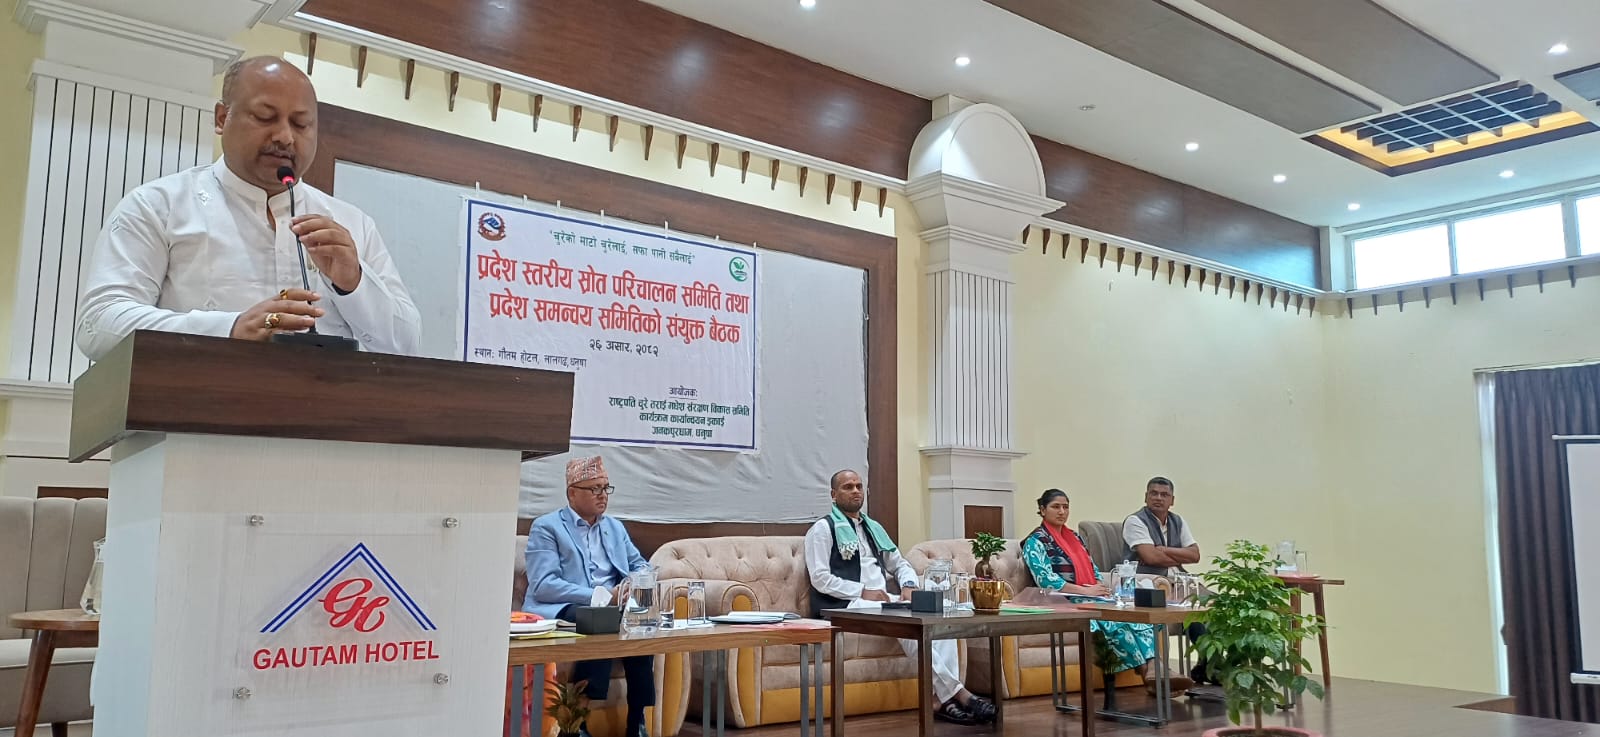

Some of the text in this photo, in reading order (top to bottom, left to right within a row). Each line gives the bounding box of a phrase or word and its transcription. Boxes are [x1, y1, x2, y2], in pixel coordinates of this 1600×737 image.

[579, 234, 597, 248] माटो
[632, 245, 648, 257] सफा
[651, 247, 666, 260] पानी
[477, 249, 750, 315] प्रदेश स्तरीय स्रोत परिचालन समिति तथा
[489, 287, 741, 345] प्रदेश समन्वय समितिको संयुक्त बैठक
[498, 346, 517, 361] गौतम
[589, 338, 602, 352] २६
[635, 343, 659, 357] २०८२
[608, 396, 636, 408] राष्ट्रपति
[638, 397, 648, 410] चुरे
[650, 398, 666, 411] तराई
[686, 401, 709, 413] संरक्षण
[710, 402, 731, 415] विकास
[732, 405, 750, 417] समिति
[639, 411, 725, 427] कार्यक्रम कार्यान्वयन इकाई
[695, 428, 713, 440] धनुषा
[253, 640, 440, 670] GAUTAM HOTEL
